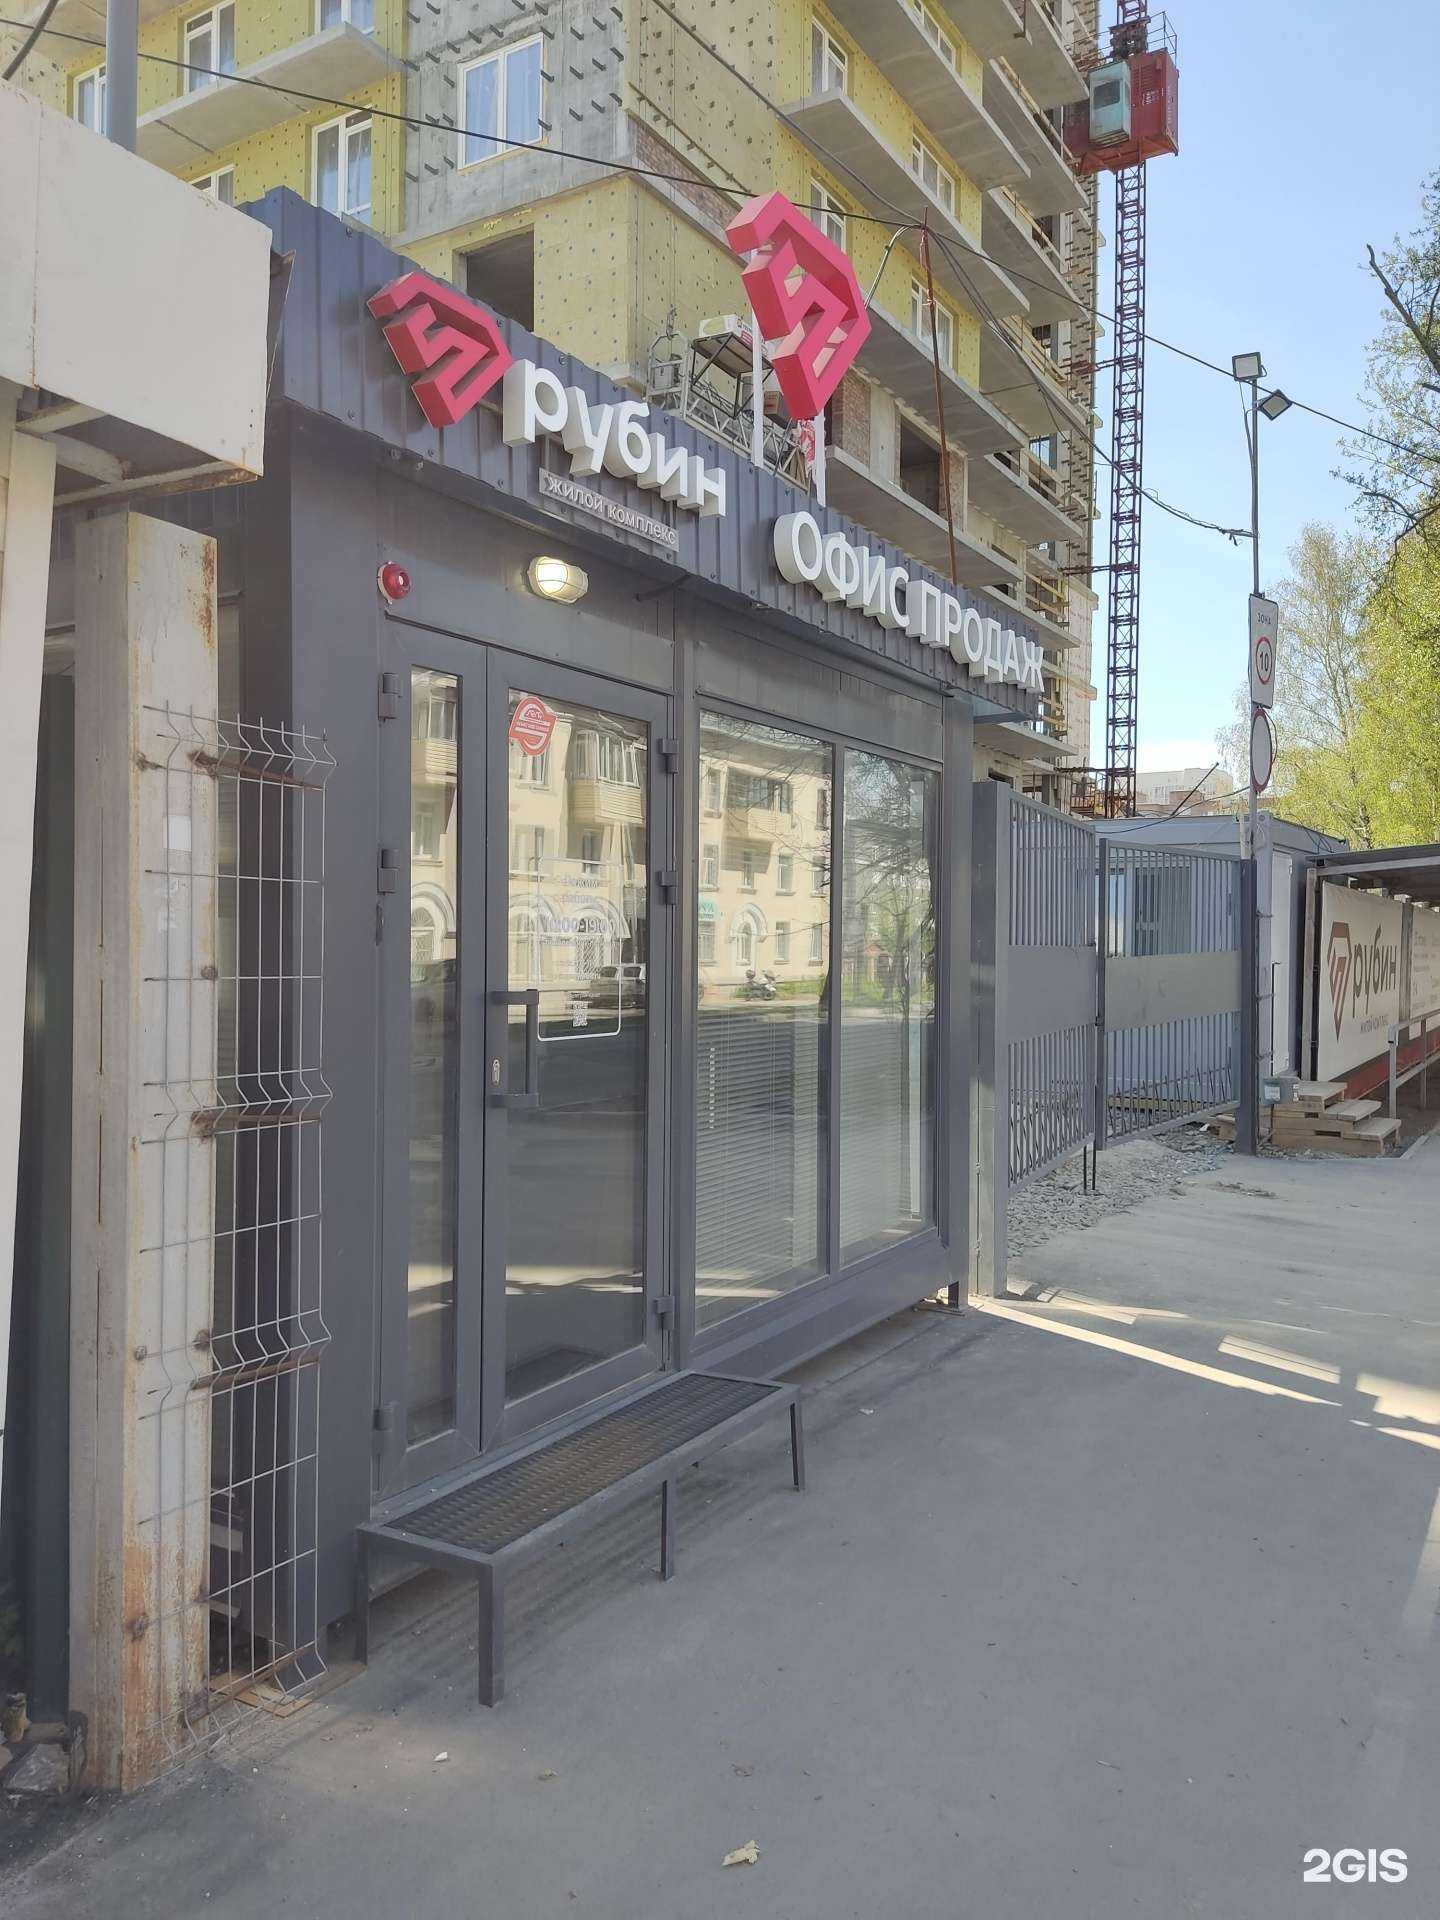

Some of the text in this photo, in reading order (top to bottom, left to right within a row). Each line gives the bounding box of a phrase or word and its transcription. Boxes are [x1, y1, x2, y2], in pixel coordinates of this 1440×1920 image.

[503, 358, 726, 519] рубин
[547, 475, 677, 545] жилой комплекс
[774, 511, 1045, 693] ОФИС ПРОДАЖ
[1259, 650, 1270, 672] 10
[1352, 922, 1398, 1019] рубин
